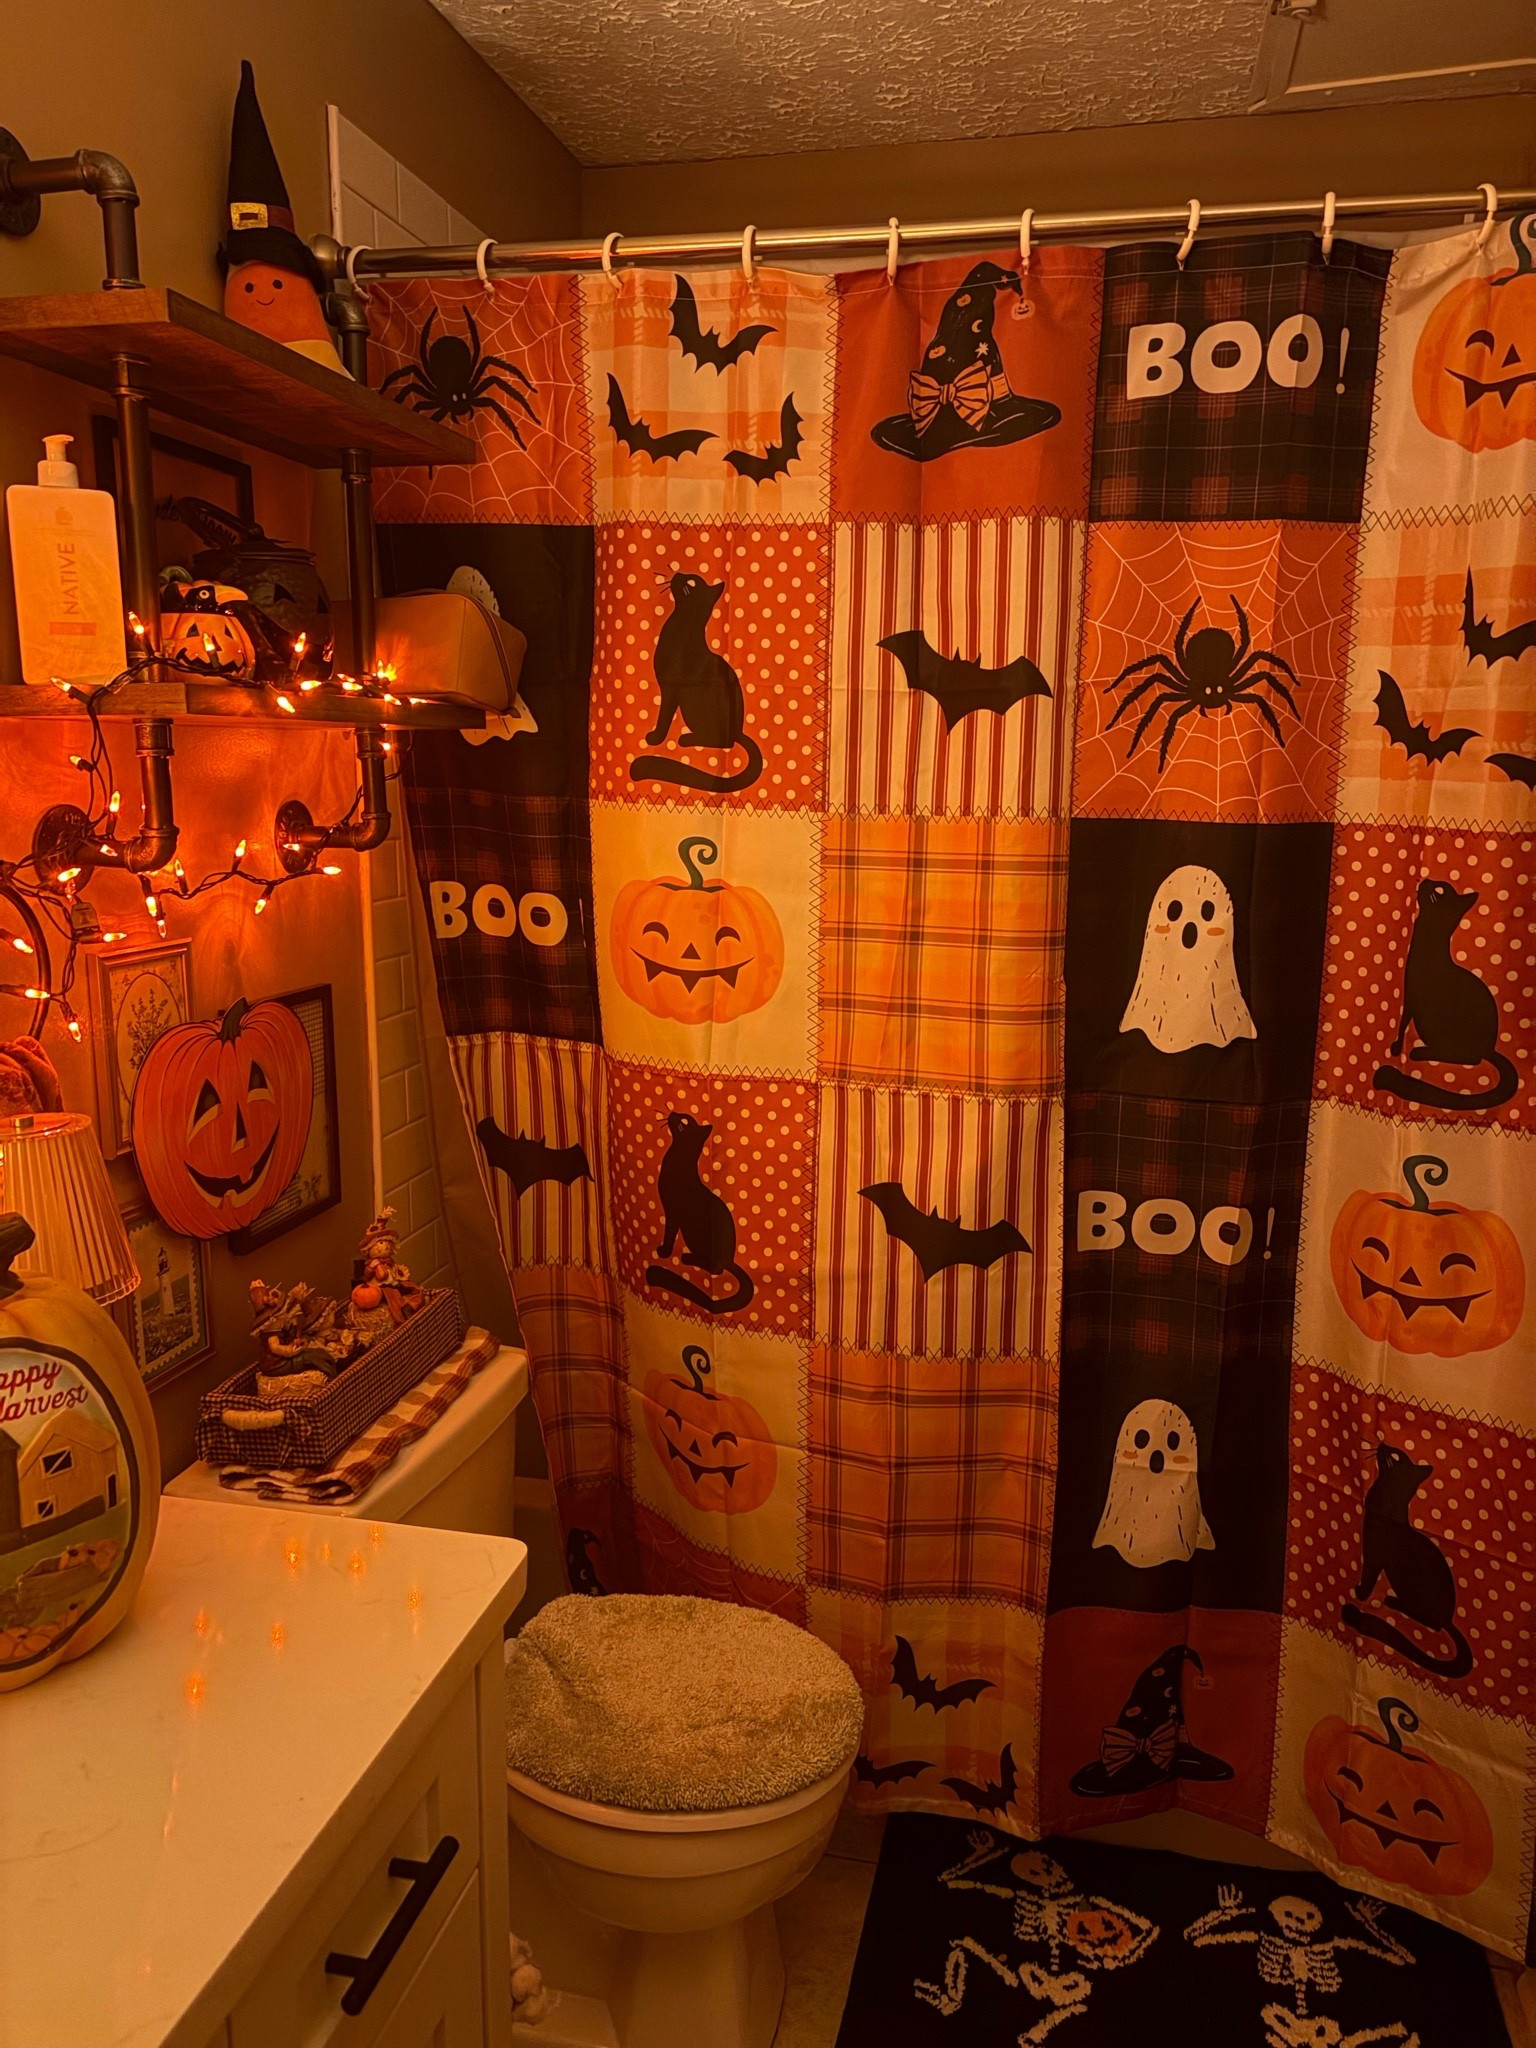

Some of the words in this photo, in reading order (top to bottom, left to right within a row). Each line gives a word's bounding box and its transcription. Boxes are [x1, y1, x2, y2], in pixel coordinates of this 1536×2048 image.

[1126, 313, 1350, 400] BOO!
[57, 543, 80, 615] NATIVE
[1077, 1189, 1275, 1266] BOO!
[0, 1382, 88, 1423] arvest
